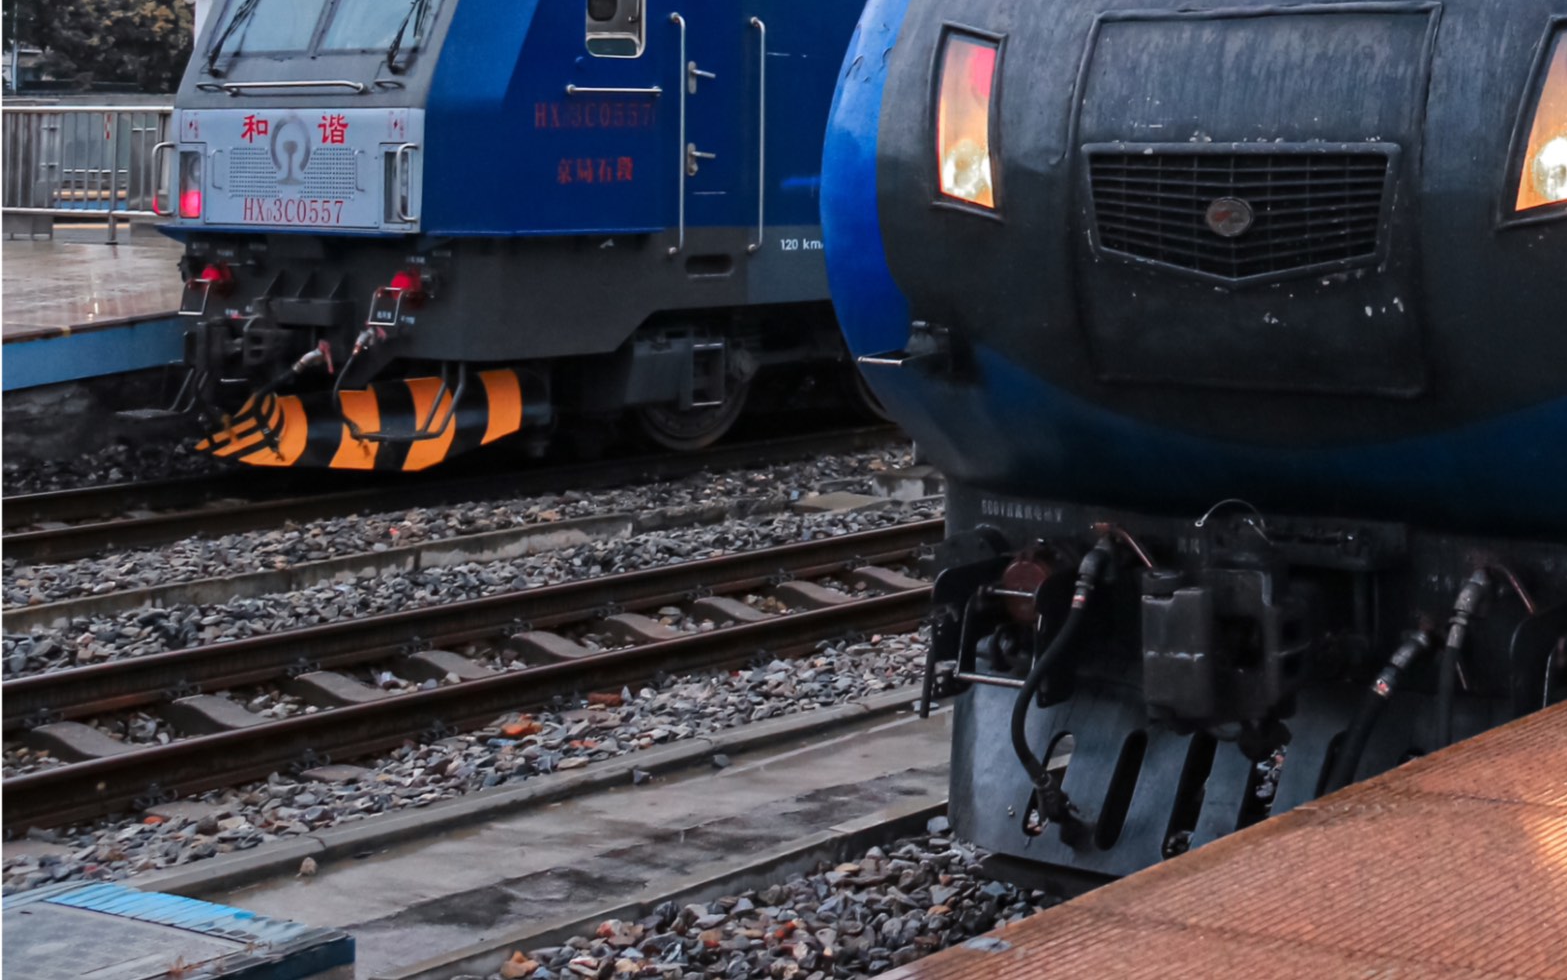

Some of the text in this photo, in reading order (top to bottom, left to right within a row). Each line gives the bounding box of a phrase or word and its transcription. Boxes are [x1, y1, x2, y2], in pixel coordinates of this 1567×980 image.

[241, 114, 349, 144] 和 谐
[780, 238, 799, 251] 120
